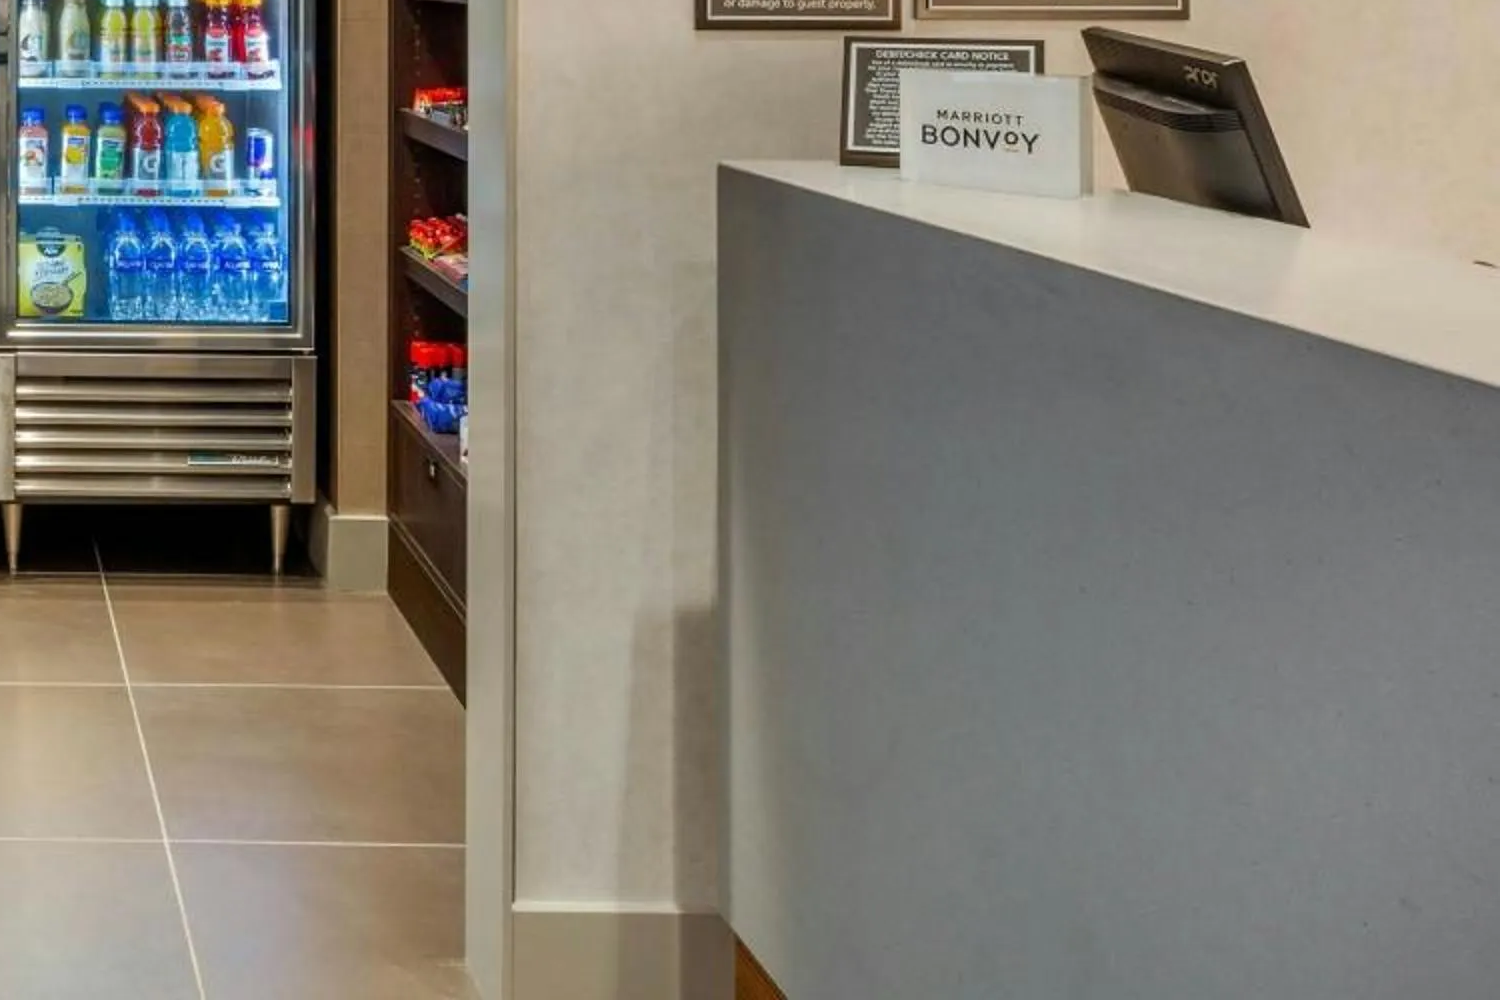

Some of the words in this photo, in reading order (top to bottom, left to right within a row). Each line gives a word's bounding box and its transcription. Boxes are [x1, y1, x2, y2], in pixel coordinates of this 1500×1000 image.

[723, 0, 736, 9] or
[797, 0, 826, 11] guest
[940, 50, 970, 60] CARD
[971, 51, 1009, 61] NOTICE
[936, 109, 1024, 126] MARRIOTT
[920, 124, 1041, 154] BONVOY
